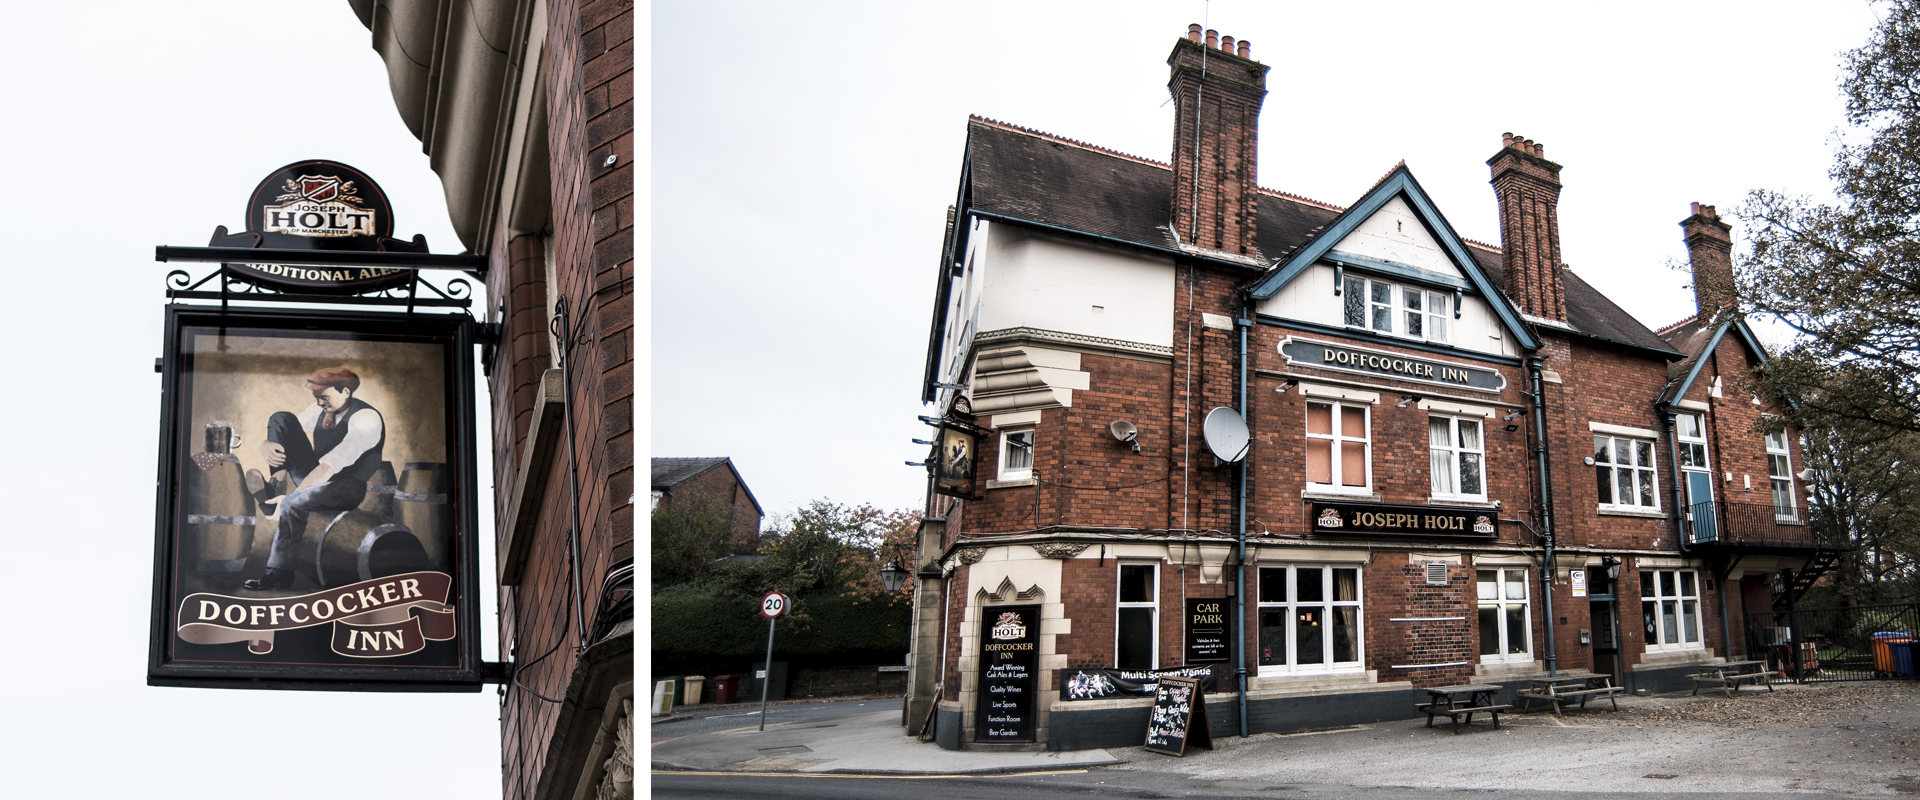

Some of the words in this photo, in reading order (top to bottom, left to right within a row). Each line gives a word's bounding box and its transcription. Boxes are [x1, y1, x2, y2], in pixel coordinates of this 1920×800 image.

[294, 204, 346, 212] JOSEPH
[270, 212, 370, 230] HOLT
[1324, 349, 1434, 378] DOFFCOCKER
[1442, 367, 1468, 382] INN
[1352, 512, 1419, 528] JOSEPH
[1424, 515, 1466, 530] HOLT
[198, 578, 422, 625] DOFFCOCKER
[765, 599, 782, 610] 20
[1197, 603, 1220, 612] CAR
[1194, 615, 1223, 624] PARK
[346, 630, 404, 650] INN
[985, 643, 1034, 651] DOFFCOCKER
[1121, 671, 1146, 679] Multi
[1148, 670, 1180, 678] Screen
[1181, 668, 1211, 677] Venue
